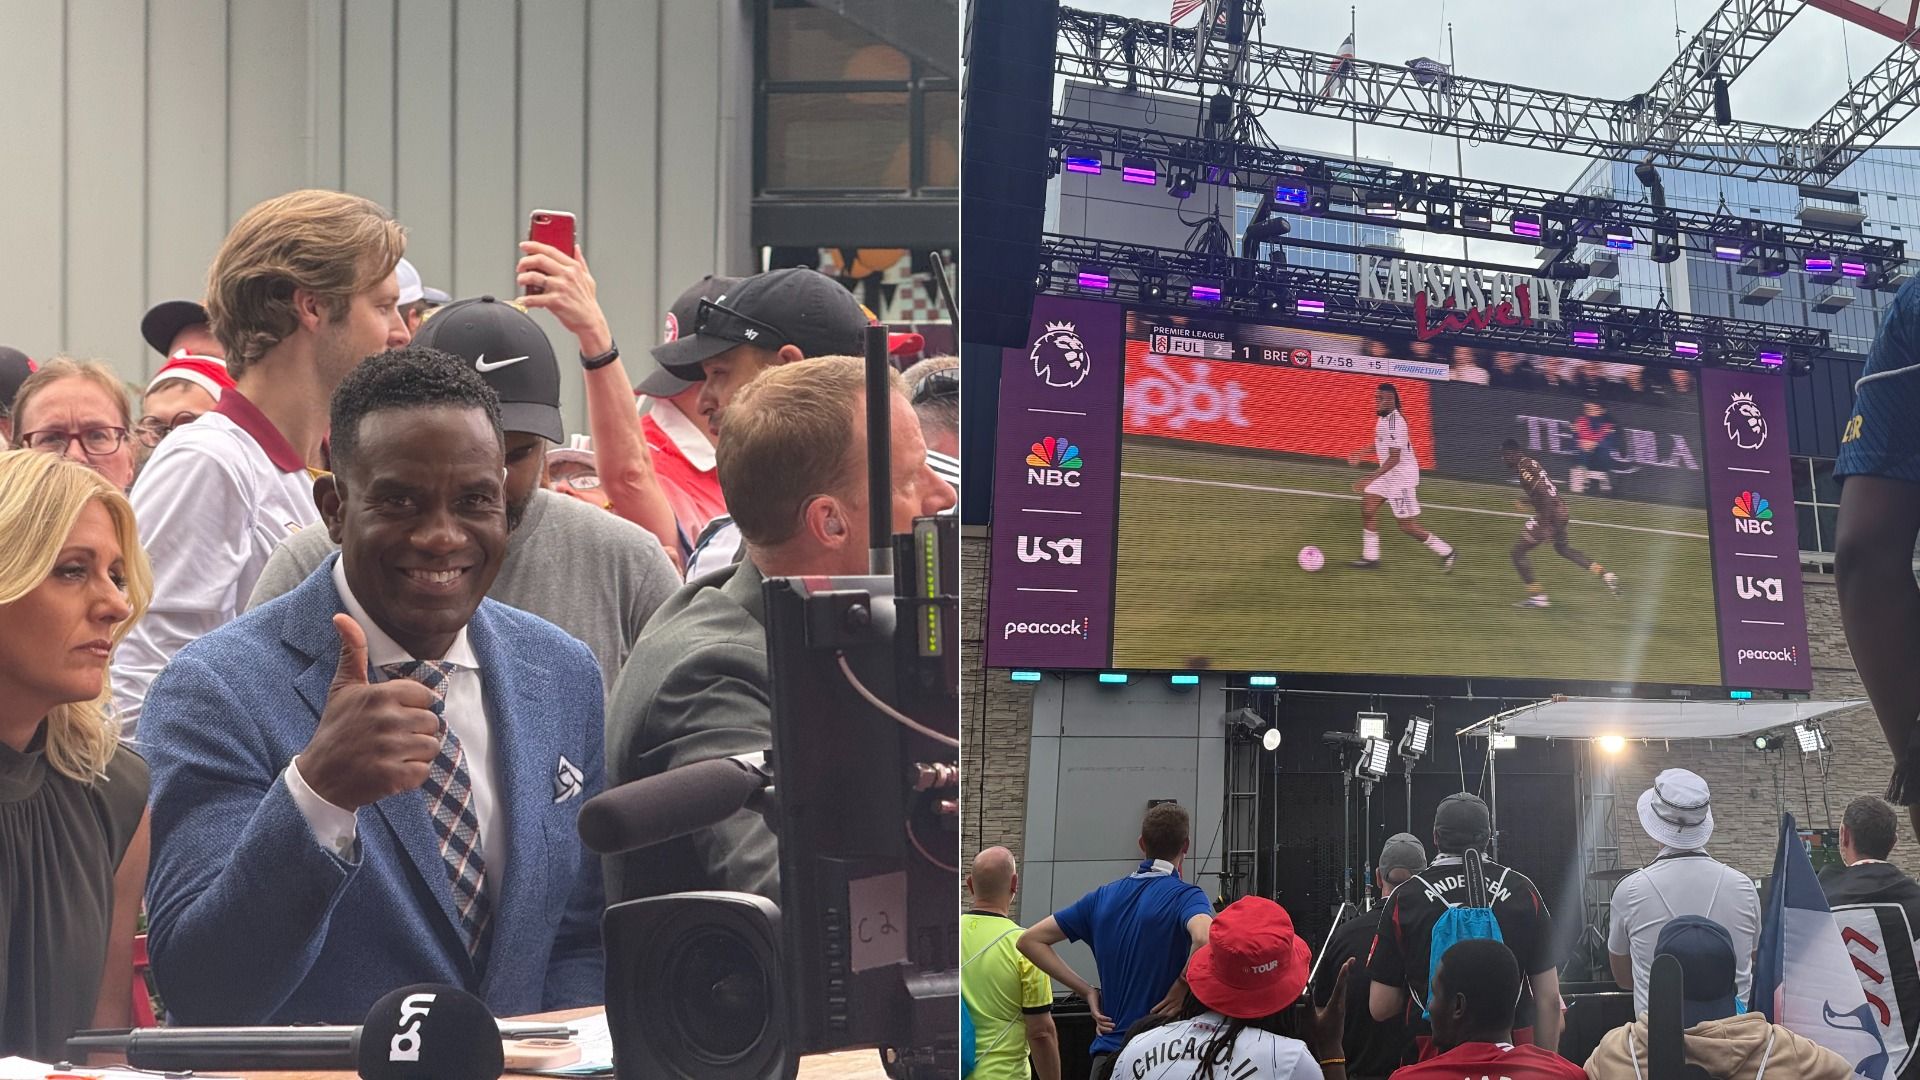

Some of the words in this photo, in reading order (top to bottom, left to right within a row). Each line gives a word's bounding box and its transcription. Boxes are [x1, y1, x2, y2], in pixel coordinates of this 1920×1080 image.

[1359, 253, 1485, 312] KANSAS
[1492, 272, 1565, 321] CITY
[1414, 283, 1534, 341] Live!
[1153, 326, 1190, 338] PREMIER
[1192, 331, 1225, 340] LEAGUE
[1174, 340, 1200, 353] FUL
[1213, 344, 1223, 356] 2
[1242, 346, 1250, 359] 1
[1263, 350, 1288, 362] BRE
[1317, 355, 1353, 368] 47:58
[1368, 361, 1382, 370] +5
[1027, 468, 1081, 488] NBC
[1735, 518, 1774, 535] NBC
[1004, 619, 1082, 640] peacock
[1737, 648, 1792, 665] peacock
[1251, 960, 1279, 975] TOUR
